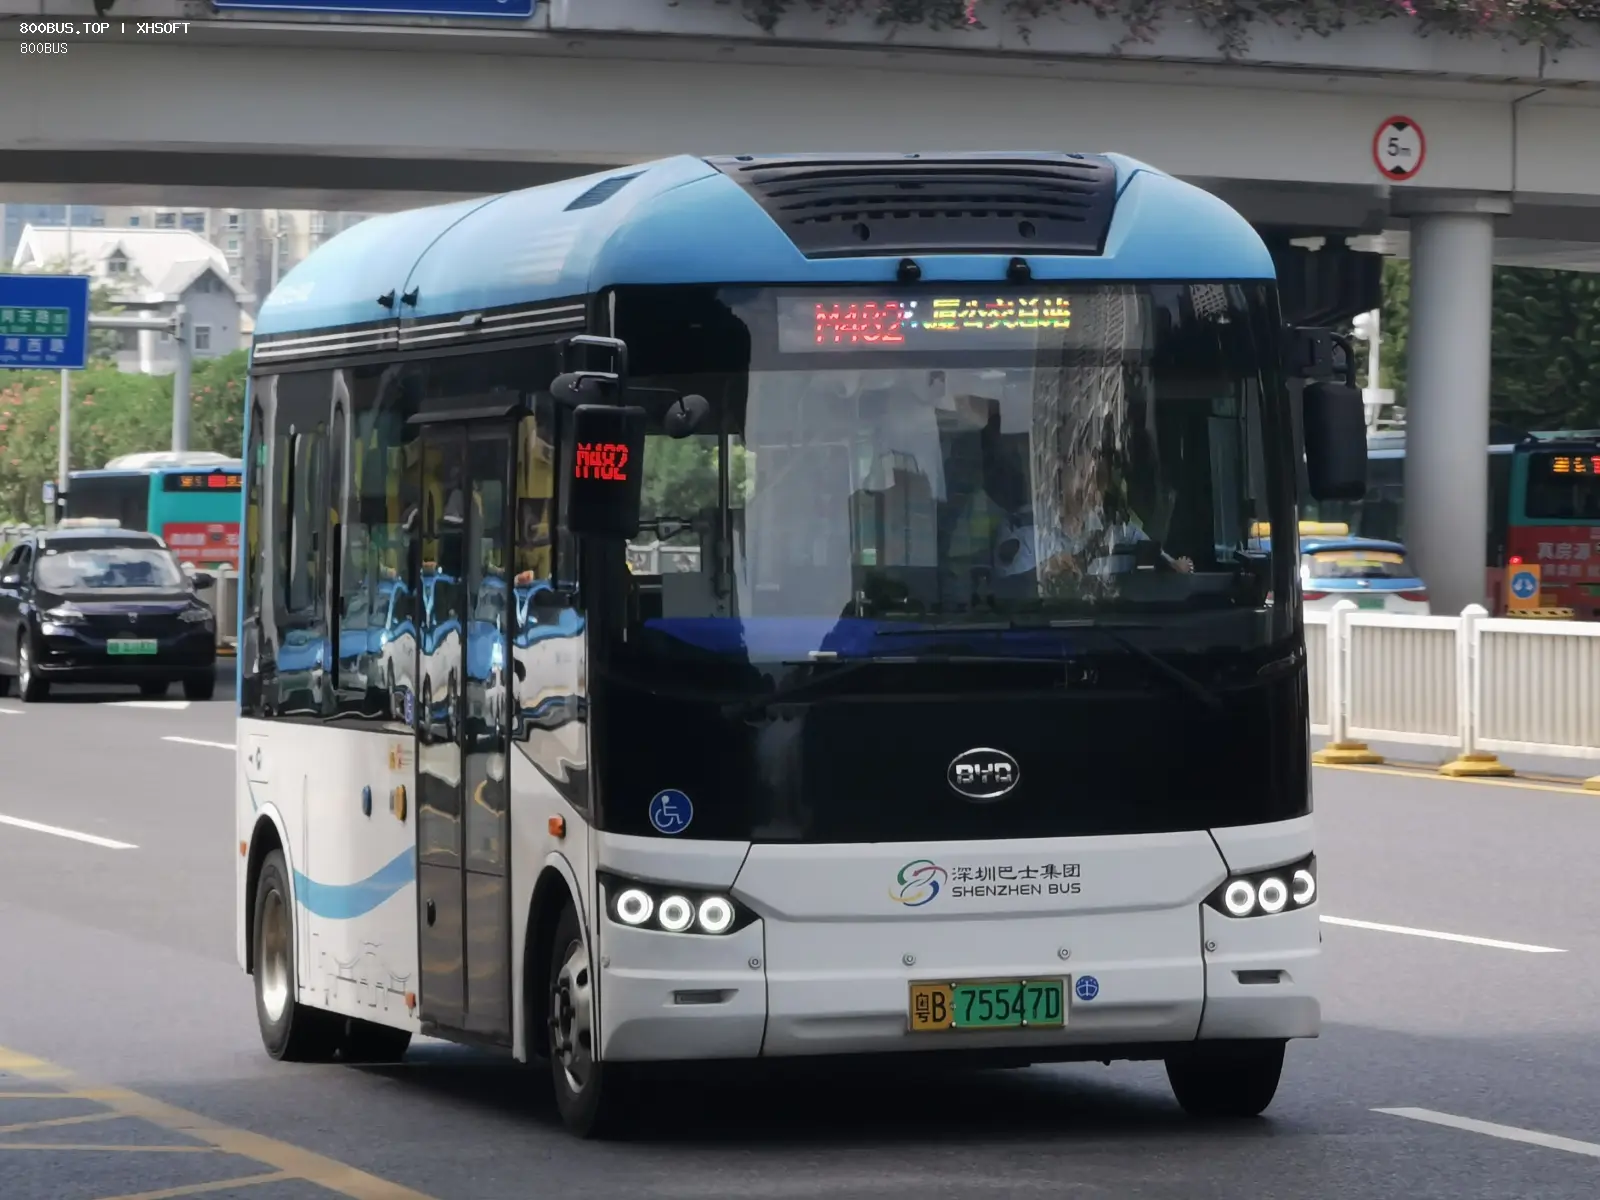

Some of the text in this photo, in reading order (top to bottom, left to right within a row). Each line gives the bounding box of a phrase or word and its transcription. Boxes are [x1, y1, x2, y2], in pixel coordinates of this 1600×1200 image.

[815, 302, 905, 344] M482
[575, 442, 629, 481] M482
[955, 763, 1012, 784] BYD
[952, 863, 1081, 883] 深圳巴士集团
[952, 882, 1081, 898] SHENZHEN BUS
[960, 987, 1060, 1022] 75547D
